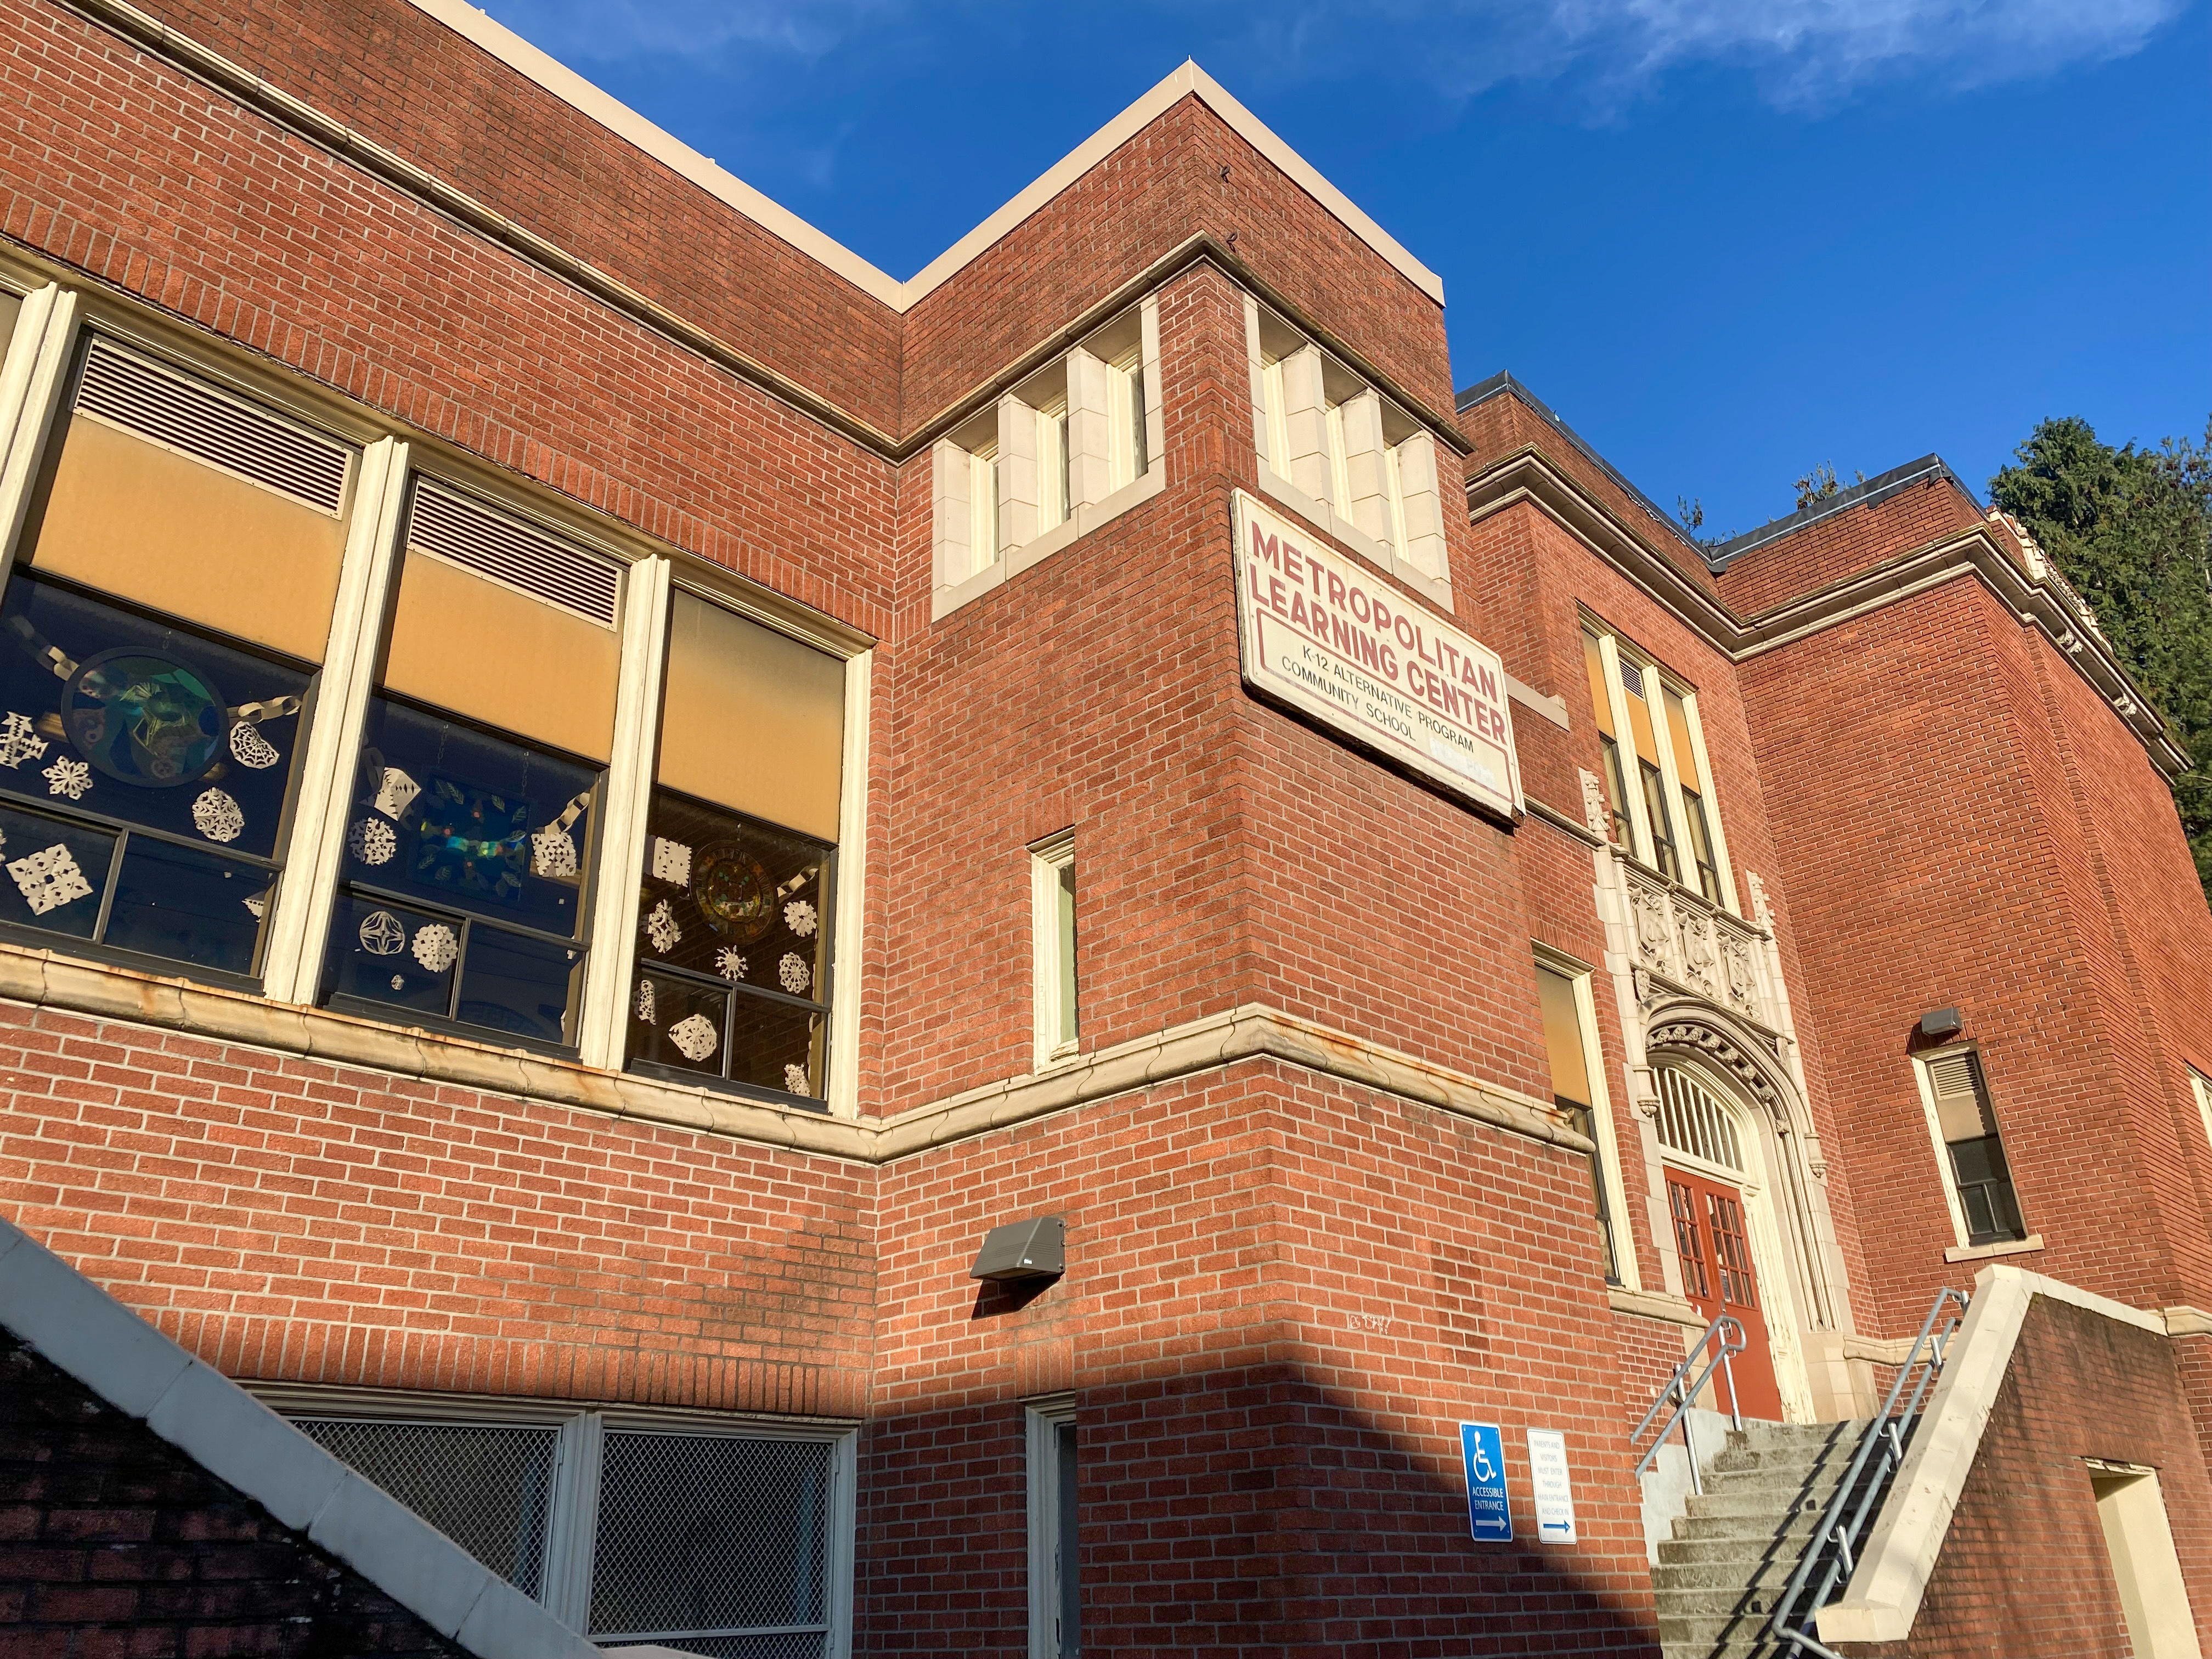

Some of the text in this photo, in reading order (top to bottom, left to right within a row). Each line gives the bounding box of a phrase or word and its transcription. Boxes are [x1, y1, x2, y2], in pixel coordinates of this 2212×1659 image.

[1251, 520, 1498, 703] METROPOLITAN
[1250, 562, 1508, 746] LEARNING CENTER
[1282, 656, 1416, 741] COMMUNITY SCHOOL
[1303, 645, 1474, 753] K-12 ALTERNATIVE PROGRAM
[1534, 1440, 1551, 1448] PARENTS
[1540, 1454, 1558, 1462] VISITORS
[1550, 1468, 1563, 1476] ENTER
[1542, 1480, 1562, 1488] THROUGH
[1472, 1486, 1504, 1498] ACCESSIBLE
[1549, 1494, 1569, 1502] ENTRANCE
[1474, 1499, 1504, 1511] ENTRANCE
